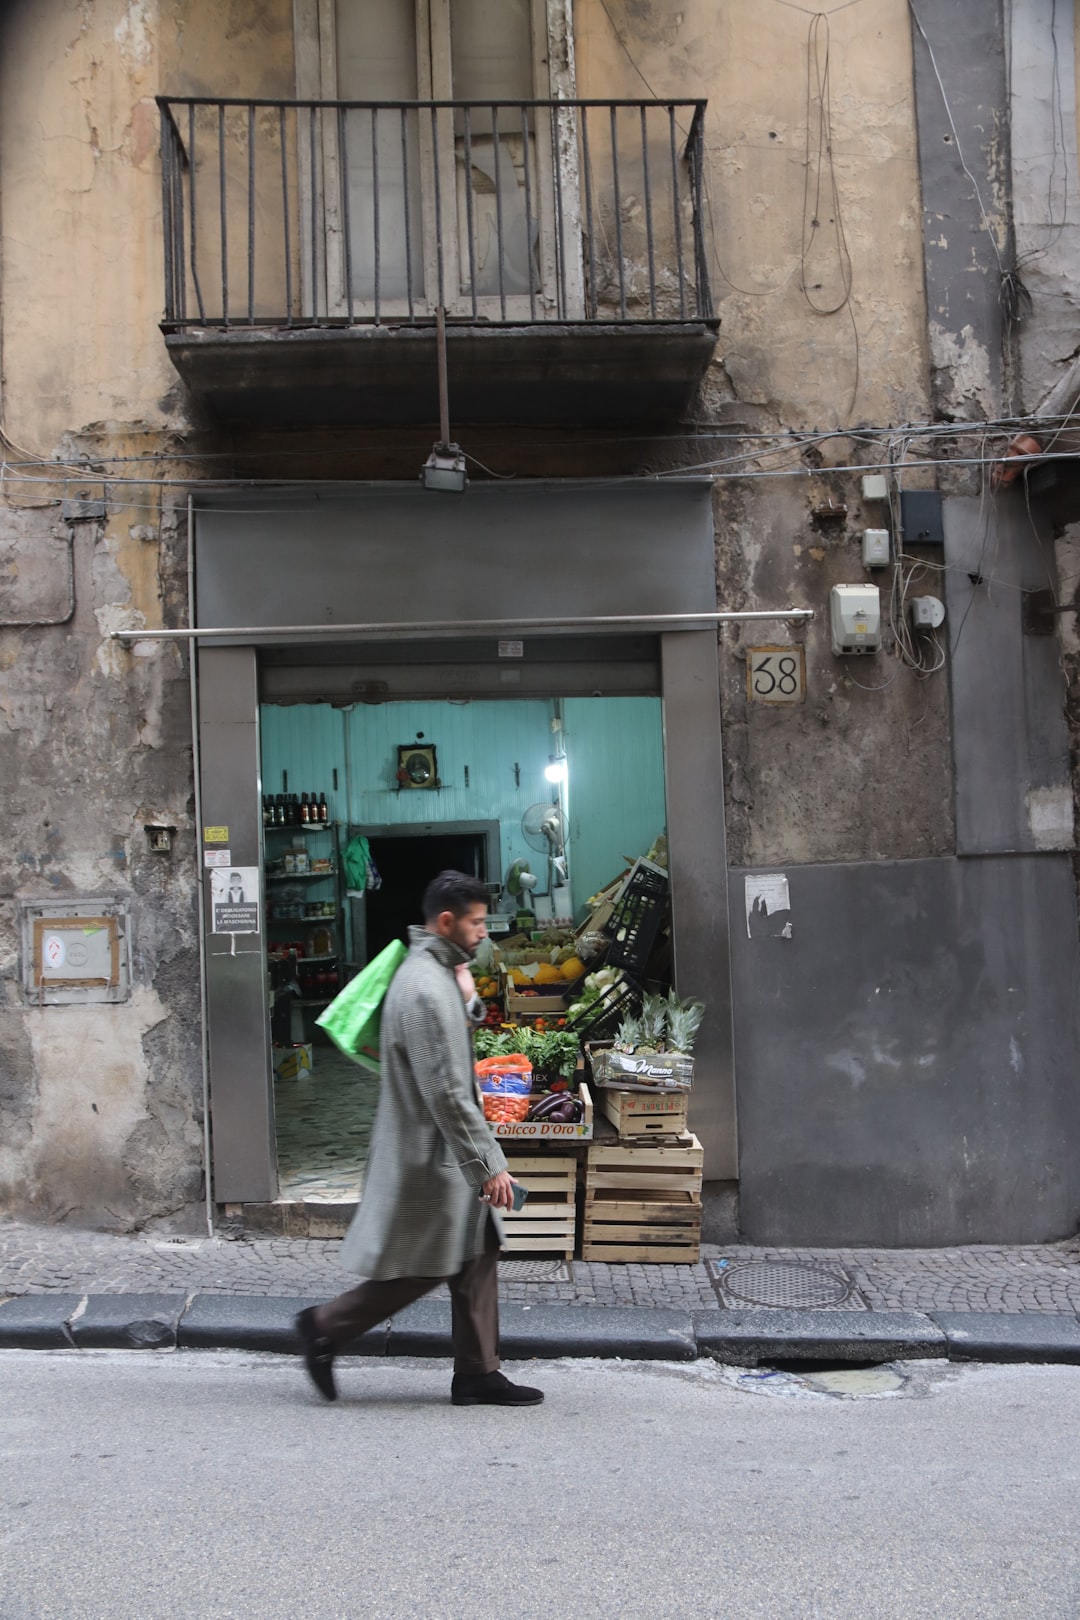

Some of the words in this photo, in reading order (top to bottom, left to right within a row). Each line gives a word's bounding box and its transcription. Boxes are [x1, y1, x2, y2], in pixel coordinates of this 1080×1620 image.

[635, 1059, 673, 1077] Manno
[496, 1124, 537, 1135] Chicco
[540, 1124, 575, 1135] D'Oro
